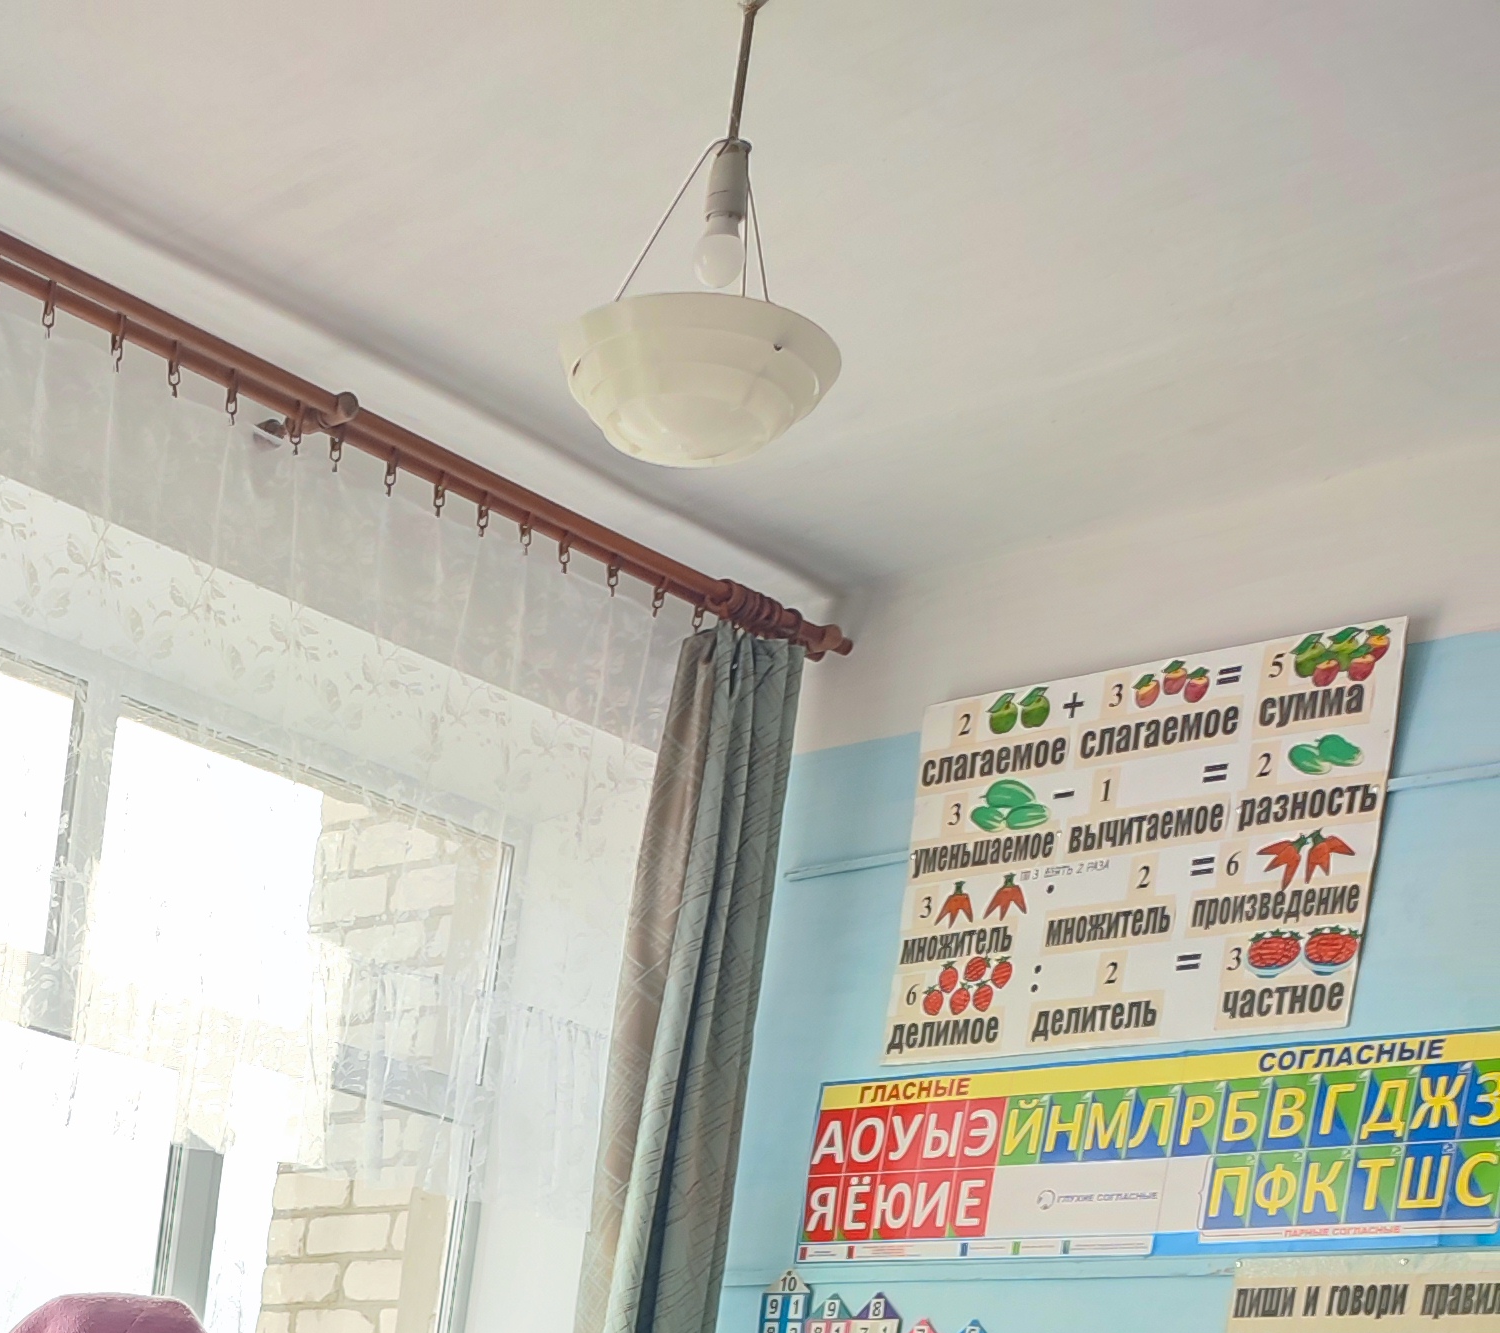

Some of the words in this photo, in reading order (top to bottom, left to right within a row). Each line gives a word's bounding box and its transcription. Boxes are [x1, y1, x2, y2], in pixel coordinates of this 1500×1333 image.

[957, 713, 972, 736] 2
[1108, 683, 1124, 708] 3
[1268, 653, 1287, 678] 5
[921, 737, 1067, 787] слагаемое
[1080, 705, 1239, 759] слагаемое
[1258, 684, 1365, 728] сумма
[946, 803, 962, 826] 3
[1100, 779, 1112, 802] 1
[1256, 753, 1273, 777] 2
[912, 831, 1055, 878] уменьшаемое
[1068, 803, 1224, 854] вычитаемое
[1237, 784, 1377, 832] разность
[918, 896, 933, 918] 3
[1135, 865, 1150, 889] 2
[1226, 851, 1242, 876] 6
[900, 925, 1013, 965] множитель
[1045, 905, 1170, 947] множитель
[1191, 883, 1360, 930] произведение
[905, 983, 921, 1006] 6
[1103, 962, 1118, 985] 2
[1226, 947, 1242, 972] 3
[886, 1016, 999, 1055] делимое
[1031, 1000, 1157, 1042] делитель
[1222, 982, 1345, 1020] частное
[859, 1078, 971, 1104] ГЛАСНЫЕ
[1258, 1038, 1446, 1073] СОГЛАСНЫЕ
[1232, 1286, 1296, 1318] пиши
[1302, 1285, 1321, 1316] и
[1325, 1284, 1409, 1319] говори
